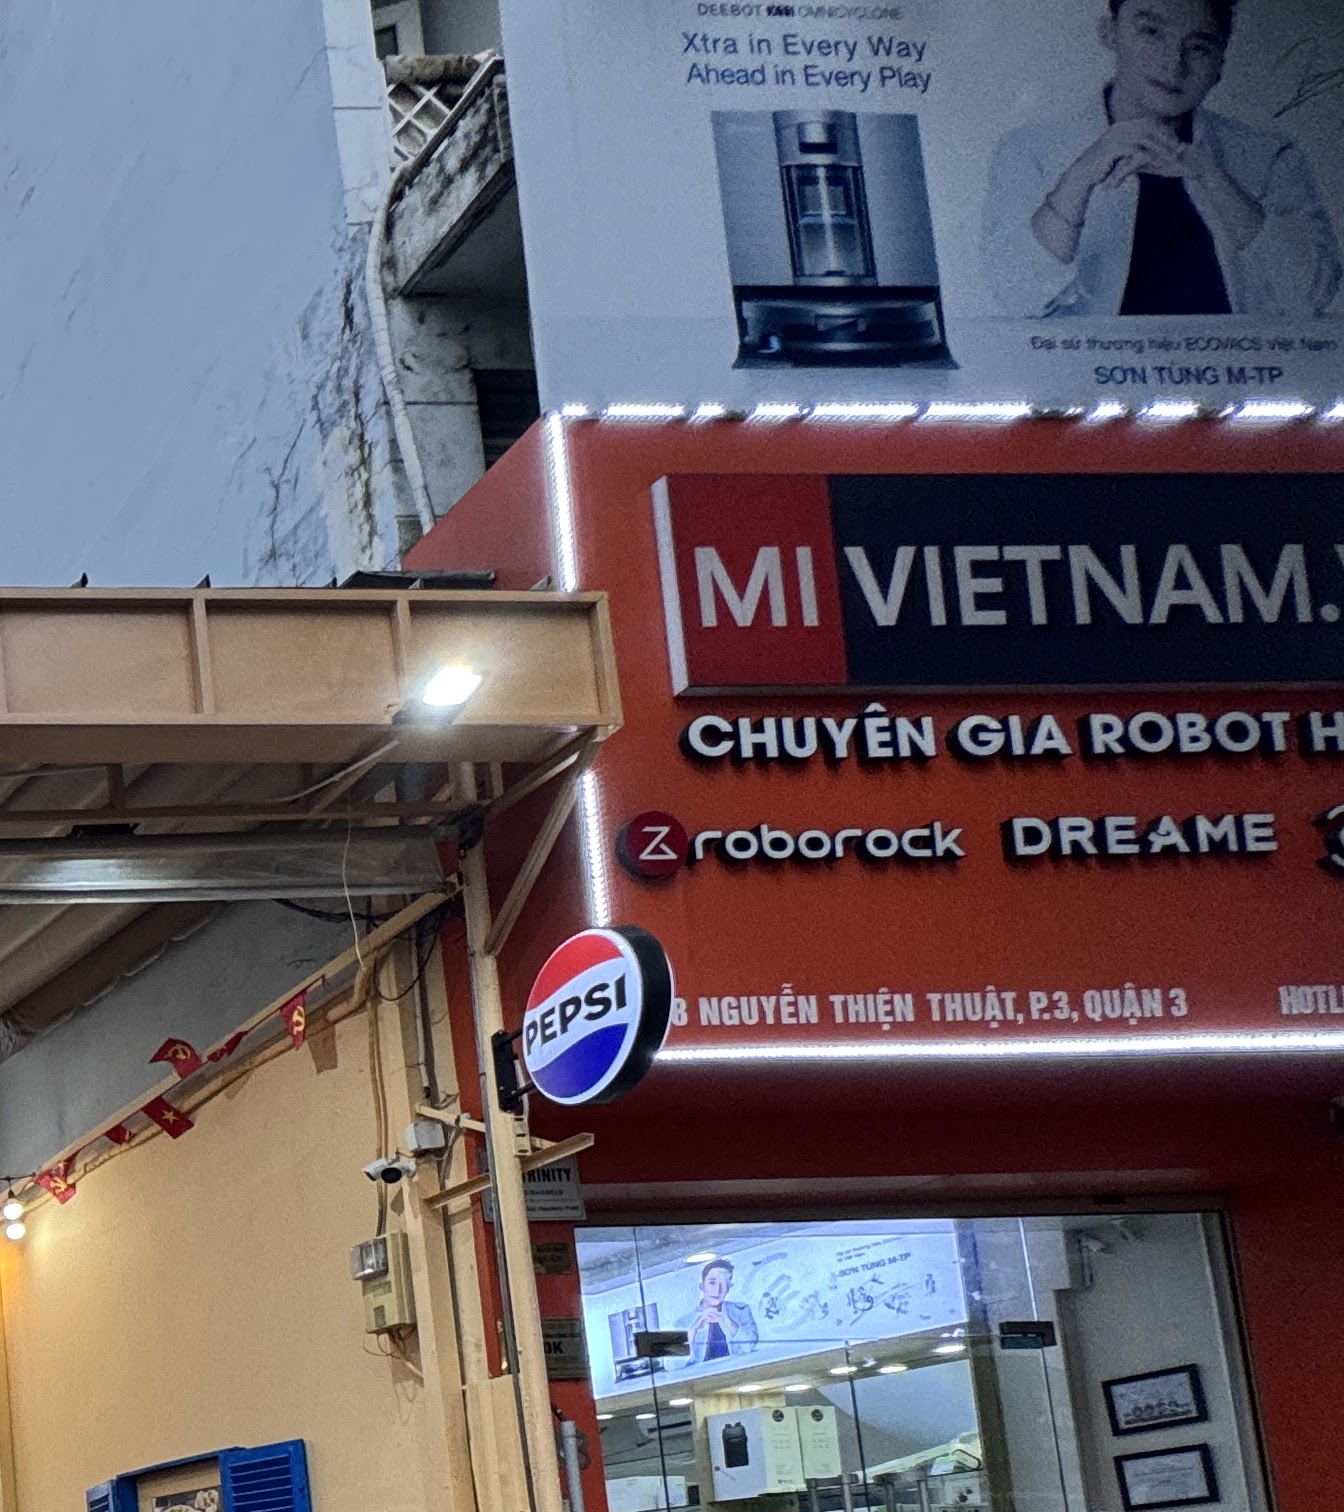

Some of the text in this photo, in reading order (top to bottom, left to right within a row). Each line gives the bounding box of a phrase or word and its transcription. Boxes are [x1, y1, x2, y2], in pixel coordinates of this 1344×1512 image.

[682, 32, 926, 62] Xtra in Every Way
[687, 63, 932, 93] Ahead in Every Play
[1226, 366, 1283, 384] M-TP
[694, 543, 1344, 628] MI VIETNAM.
[688, 702, 936, 757] CHUYÊN
[959, 713, 1069, 756] GIA
[1092, 711, 1290, 755] ROBOT
[694, 823, 964, 860] roborock
[1012, 814, 1278, 857] DREAME
[524, 974, 630, 1057] PEPSI
[699, 983, 818, 1026] NGUYỄN
[829, 987, 915, 1031] THIỆN
[926, 985, 1025, 1028] THUẬT,
[1028, 991, 1079, 1023] P.3,
[1082, 982, 1162, 1025] QUẬN
[1169, 987, 1188, 1017] 3
